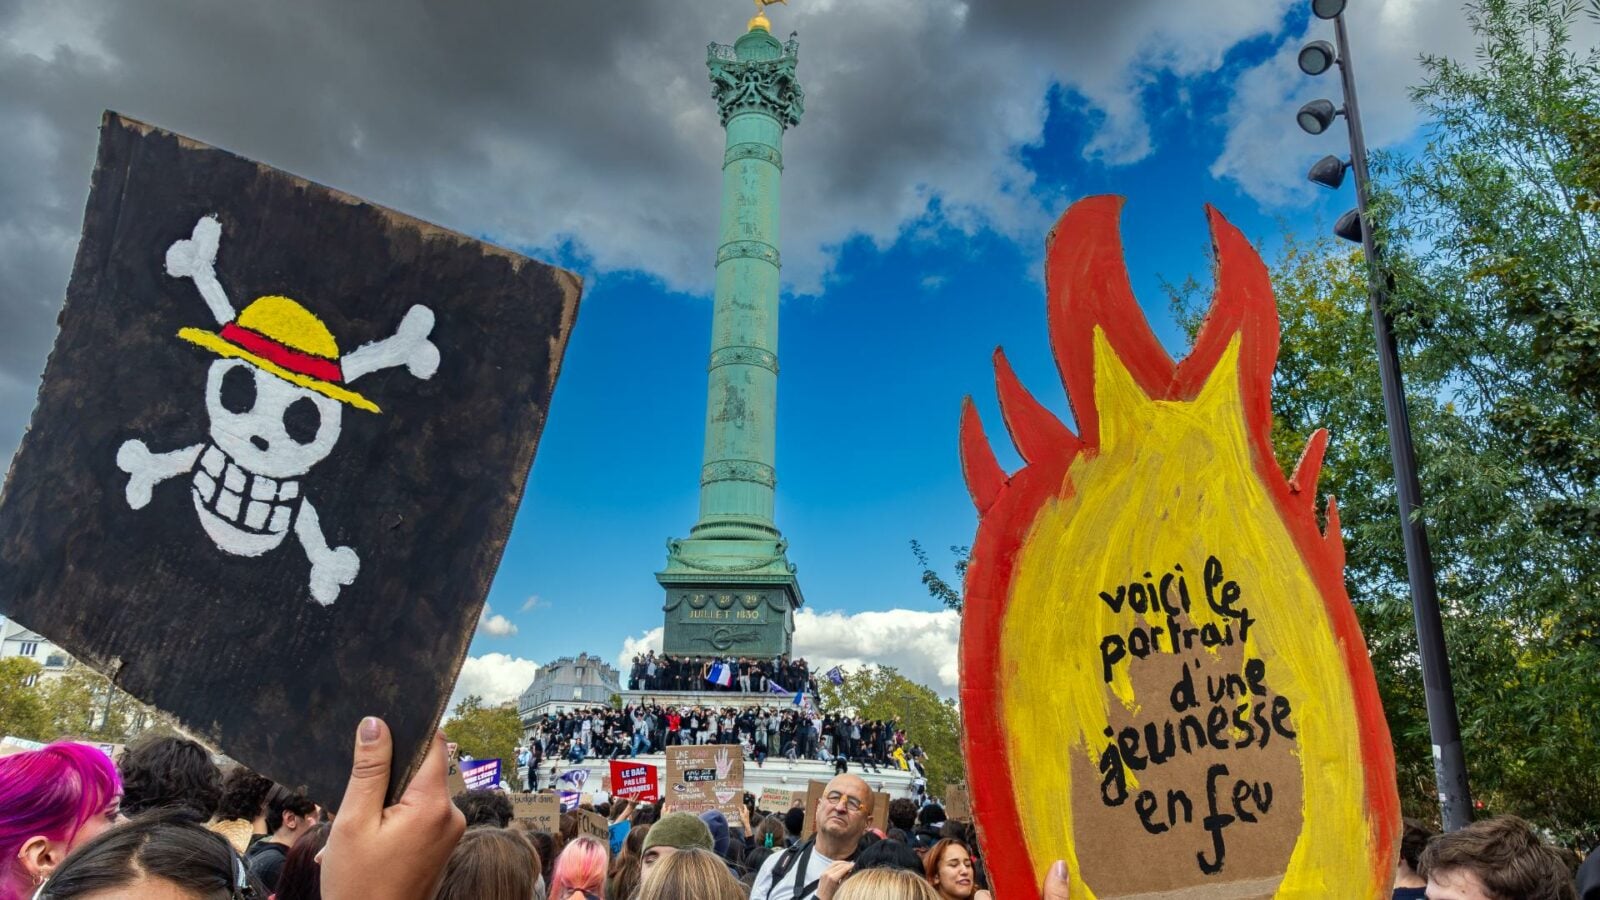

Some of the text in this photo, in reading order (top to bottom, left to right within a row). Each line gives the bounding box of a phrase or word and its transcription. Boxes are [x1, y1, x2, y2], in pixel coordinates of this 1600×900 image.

[694, 595, 757, 604] 27 28 29
[1099, 555, 1242, 618] voici le
[689, 610, 759, 619] JUILLET 1830
[1099, 607, 1256, 683] portrait
[1170, 658, 1267, 712] d'une
[621, 770, 630, 778] LE
[1099, 696, 1297, 807] jeunesse
[617, 784, 650, 795] MATRAQUES
[1135, 763, 1273, 876] en feu
